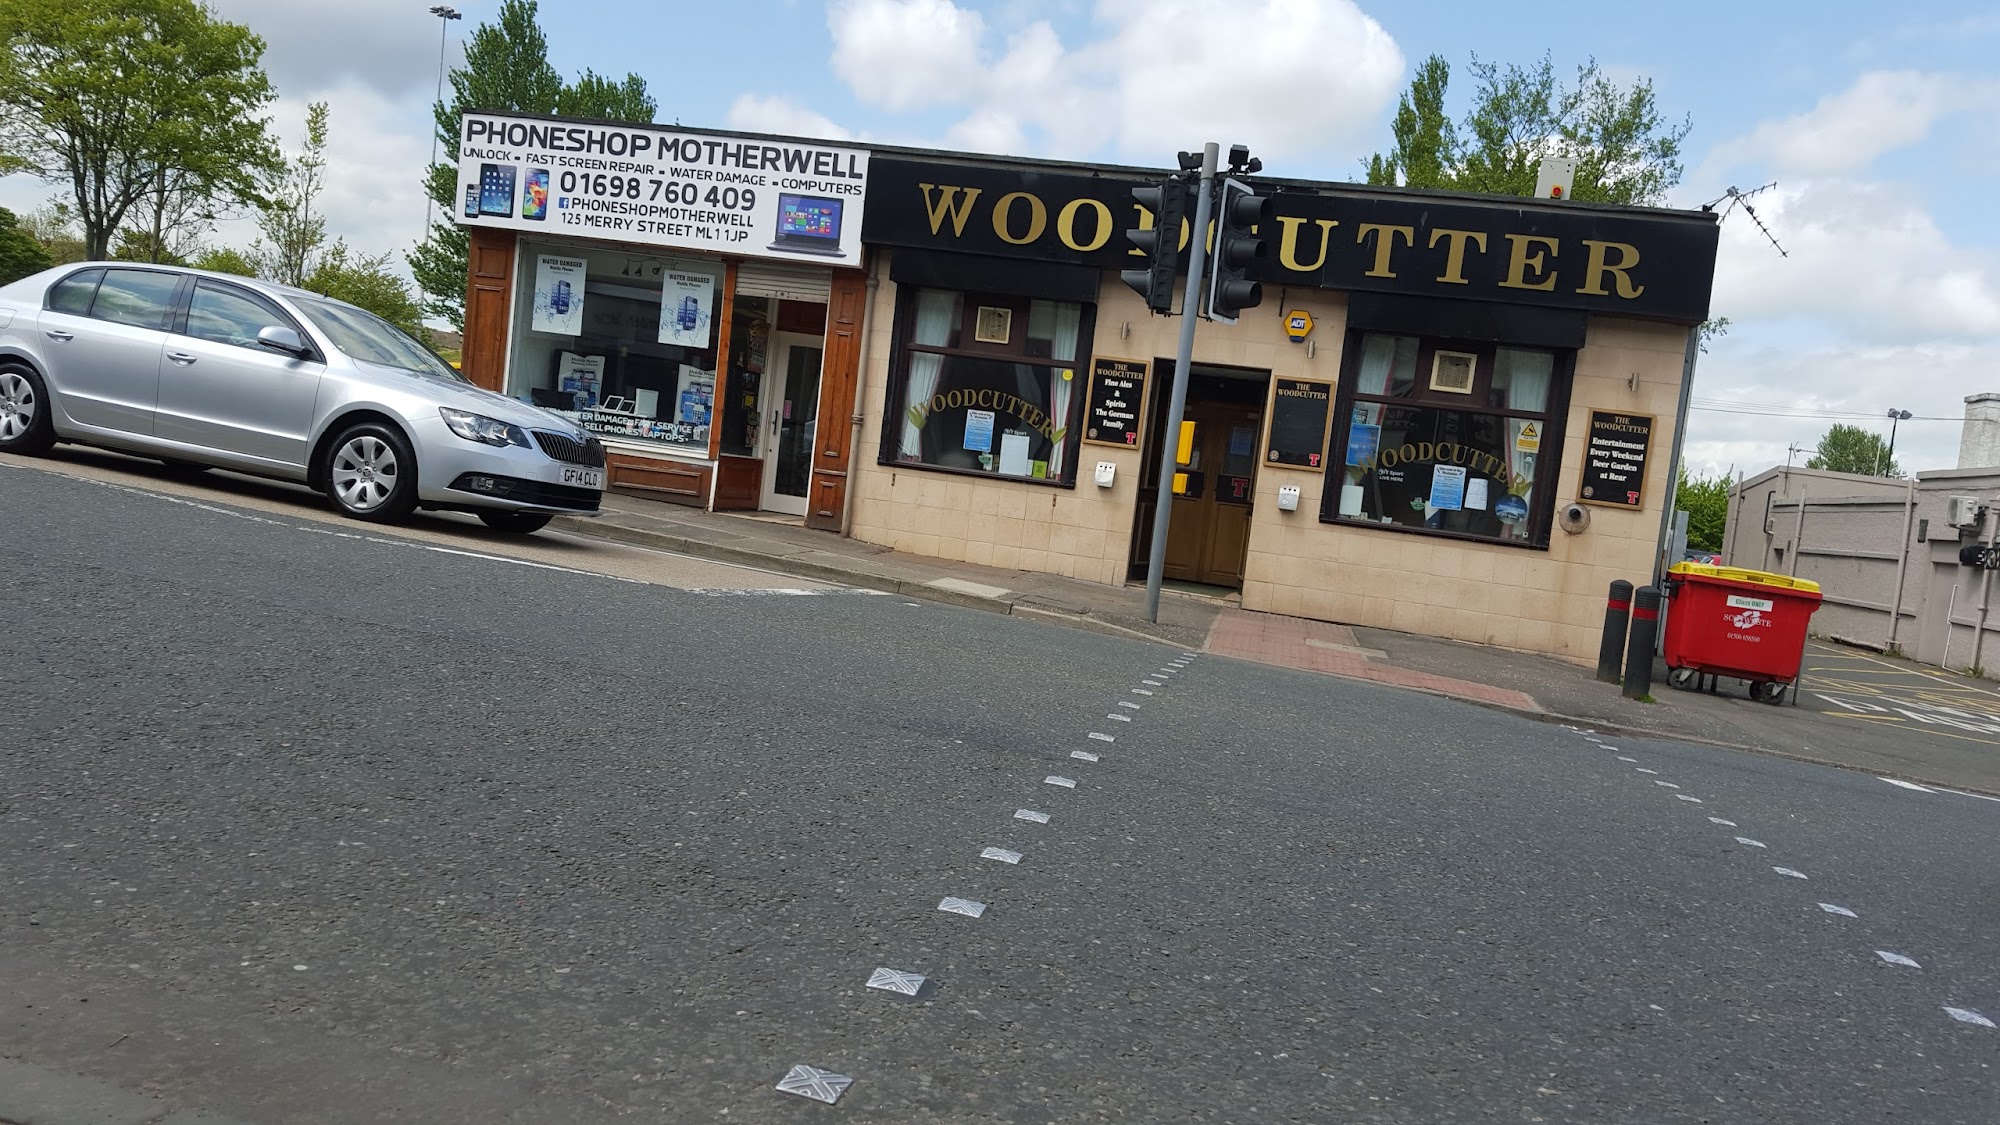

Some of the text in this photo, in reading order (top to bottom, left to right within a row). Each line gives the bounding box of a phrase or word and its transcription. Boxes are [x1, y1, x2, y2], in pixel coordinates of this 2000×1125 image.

[466, 119, 863, 180] PHONESHOP MOTHERWELL
[463, 147, 862, 196] UNLOCK FAST SCREEN REPAIR WATER DAMAGE COMPUTERS
[560, 170, 756, 212] 01698 760 409
[571, 197, 754, 228] PHONESHOPMOTHERWELL
[561, 212, 749, 243] 125 MERRY STREET ML1 1JP
[919, 182, 1645, 299] WOOUTTER
[542, 258, 583, 268] WATER DAMAGED
[669, 273, 710, 284] WATER DAMAGED
[1290, 318, 1306, 329] ADT
[1114, 363, 1128, 371] THE
[1096, 368, 1143, 380] WOODCUTTER
[1104, 378, 1133, 388] Fine Ales
[1295, 382, 1311, 391] THE
[1277, 388, 1327, 400] WOODCUTTER
[1105, 399, 1127, 408] Spirits
[911, 388, 1056, 440] WOODCUTTER
[1095, 408, 1134, 419] The Gorman
[584, 422, 603, 432] SELL
[595, 413, 628, 424] DAMAGE
[635, 418, 656, 428] FAST
[657, 421, 692, 434] SERVICE
[1102, 419, 1125, 430] Family
[1614, 416, 1630, 425] THE
[1594, 421, 1649, 435] WOODCUTTER
[1126, 431, 1136, 444] T
[1592, 437, 1645, 450] Entertainment
[1309, 453, 1320, 466] T
[1590, 448, 1644, 461] Every Weekend
[1592, 459, 1637, 472] Beer Garden
[564, 469, 583, 484] GF14
[1609, 473, 1627, 481] Rear
[1627, 491, 1639, 504] T
[1735, 598, 1765, 608] Glass ONLY
[1723, 613, 1772, 628] SCWSTE
